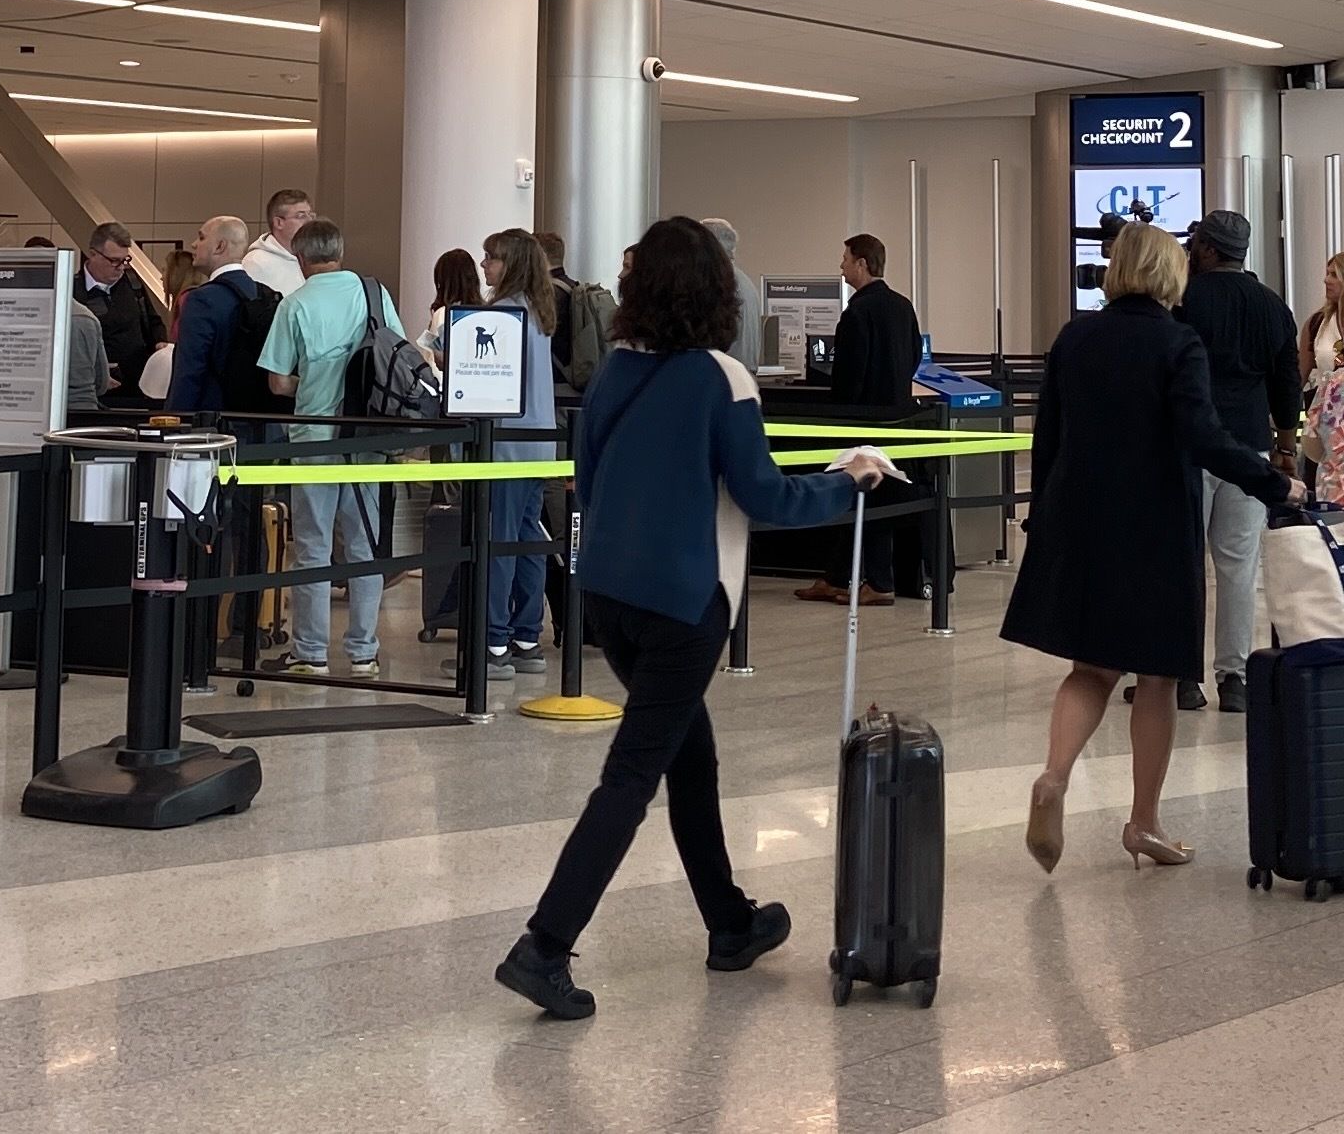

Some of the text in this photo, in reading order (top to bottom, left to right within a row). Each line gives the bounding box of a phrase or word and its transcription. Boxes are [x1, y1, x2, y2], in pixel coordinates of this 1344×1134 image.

[1102, 118, 1164, 131] SECURITY
[1169, 111, 1193, 148] 2
[1081, 132, 1164, 145] CHECKPOINT
